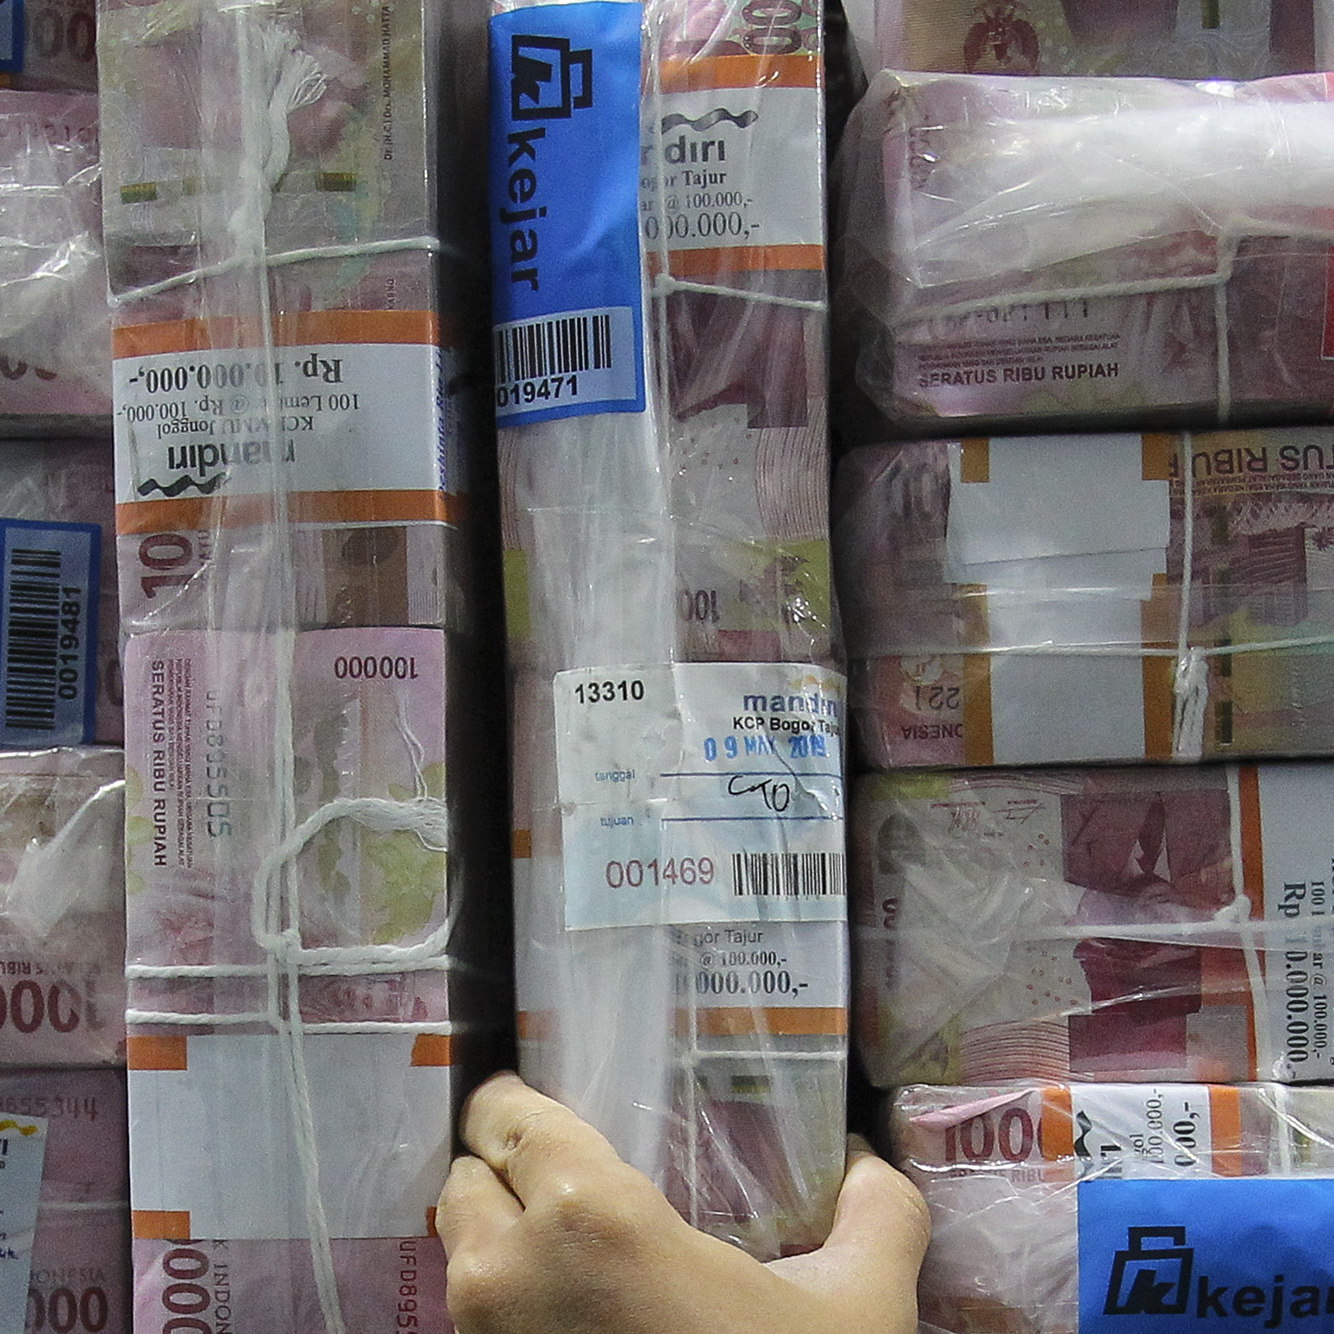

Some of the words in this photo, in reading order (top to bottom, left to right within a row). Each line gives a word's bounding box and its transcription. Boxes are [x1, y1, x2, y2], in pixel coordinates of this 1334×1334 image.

[683, 170, 727, 189] Tajur
[499, 127, 547, 291] kejar
[293, 357, 343, 386] Rp.
[920, 367, 1000, 389] SERATUS
[1004, 365, 1047, 384] RIBU
[1051, 361, 1120, 382] RUPIAH
[194, 397, 224, 418] Rp.
[328, 393, 361, 412] 100
[156, 418, 217, 438] Jonggol
[1193, 447, 1269, 475] RIBU
[58, 585, 80, 700] 0019481
[333, 655, 419, 681] 100000
[151, 660, 165, 743] SERATUS
[573, 680, 646, 704] 13310
[733, 717, 766, 731] KCP
[152, 750, 166, 792] RIBU
[593, 767, 637, 784] tanggal
[152, 800, 167, 867] RUPIAH
[599, 814, 635, 828] tujuan
[605, 857, 716, 889] 001469
[1309, 879, 1327, 906] 100
[724, 928, 765, 944] Tajur
[1310, 993, 1328, 1060] 100.000,-
